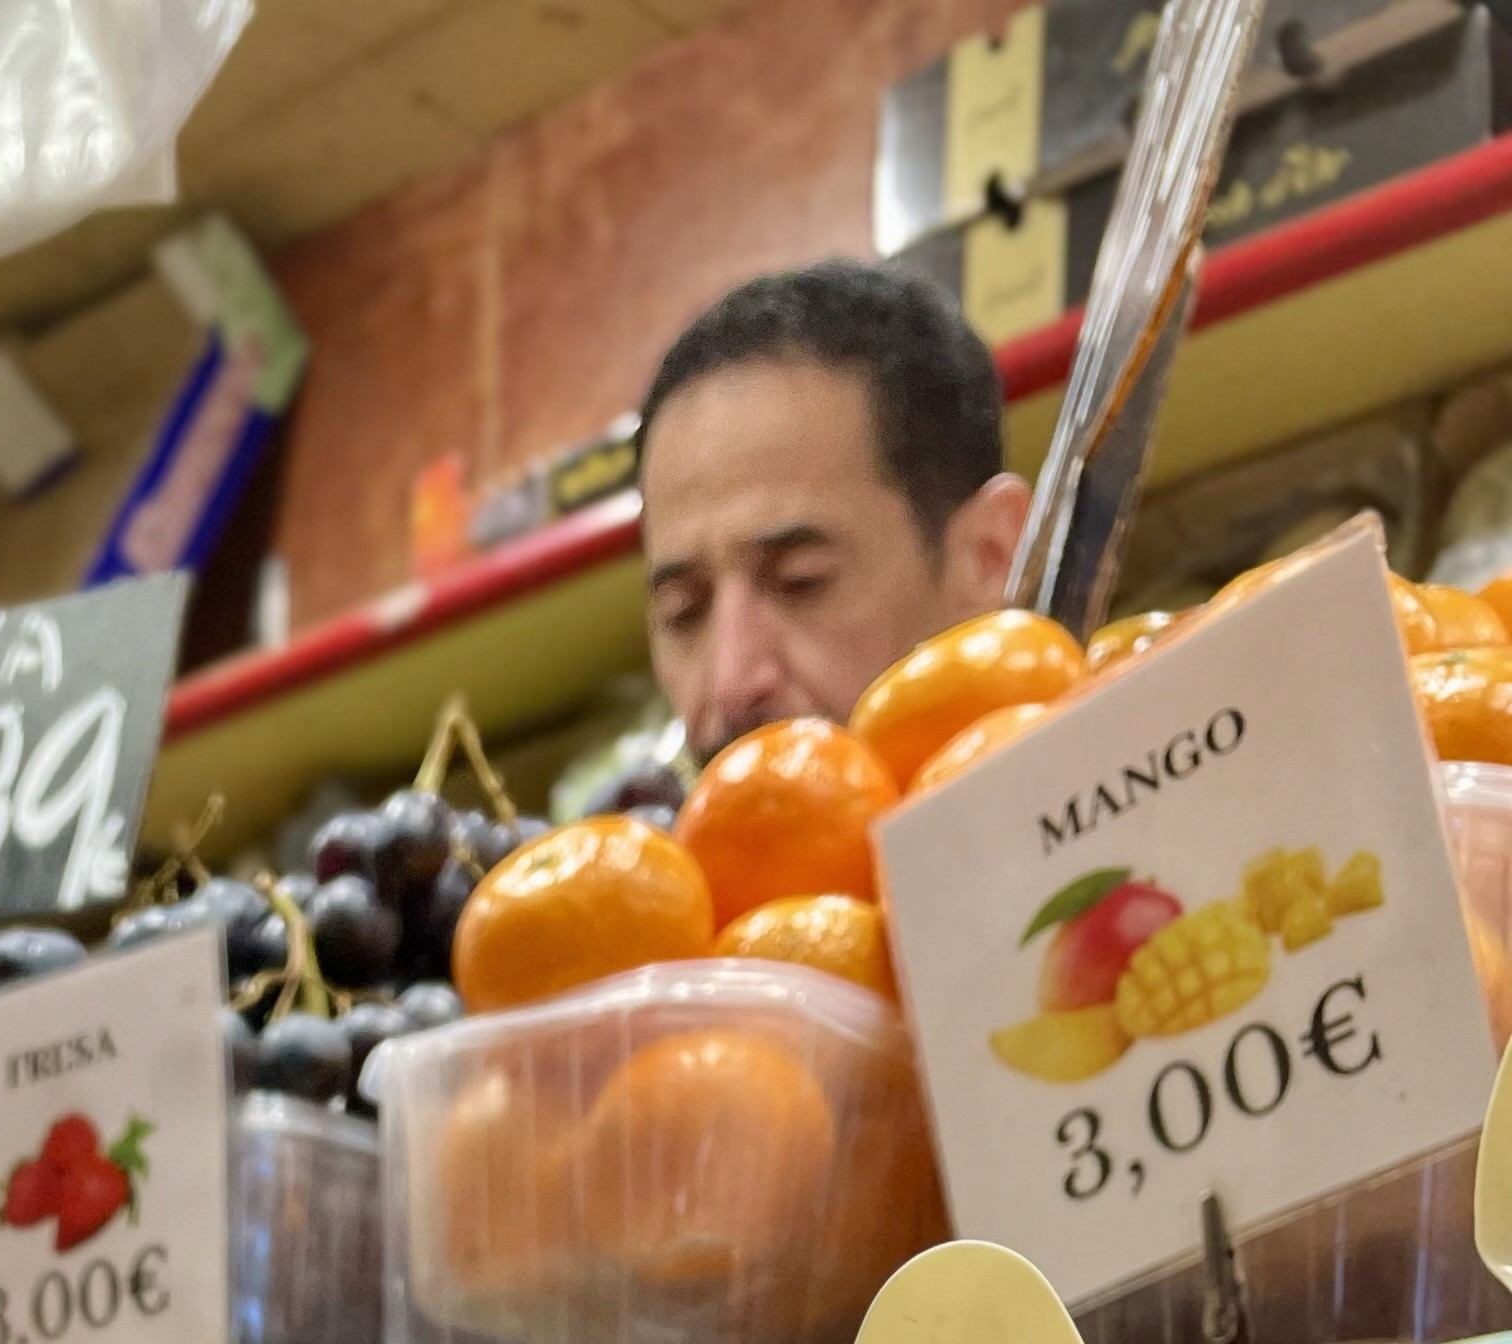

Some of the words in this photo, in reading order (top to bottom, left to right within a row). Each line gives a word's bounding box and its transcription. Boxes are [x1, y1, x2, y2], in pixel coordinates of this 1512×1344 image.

[1036, 704, 1249, 856] MANGO
[3, 1027, 120, 1091] FRESA
[1054, 973, 1386, 1203] 3,00€
